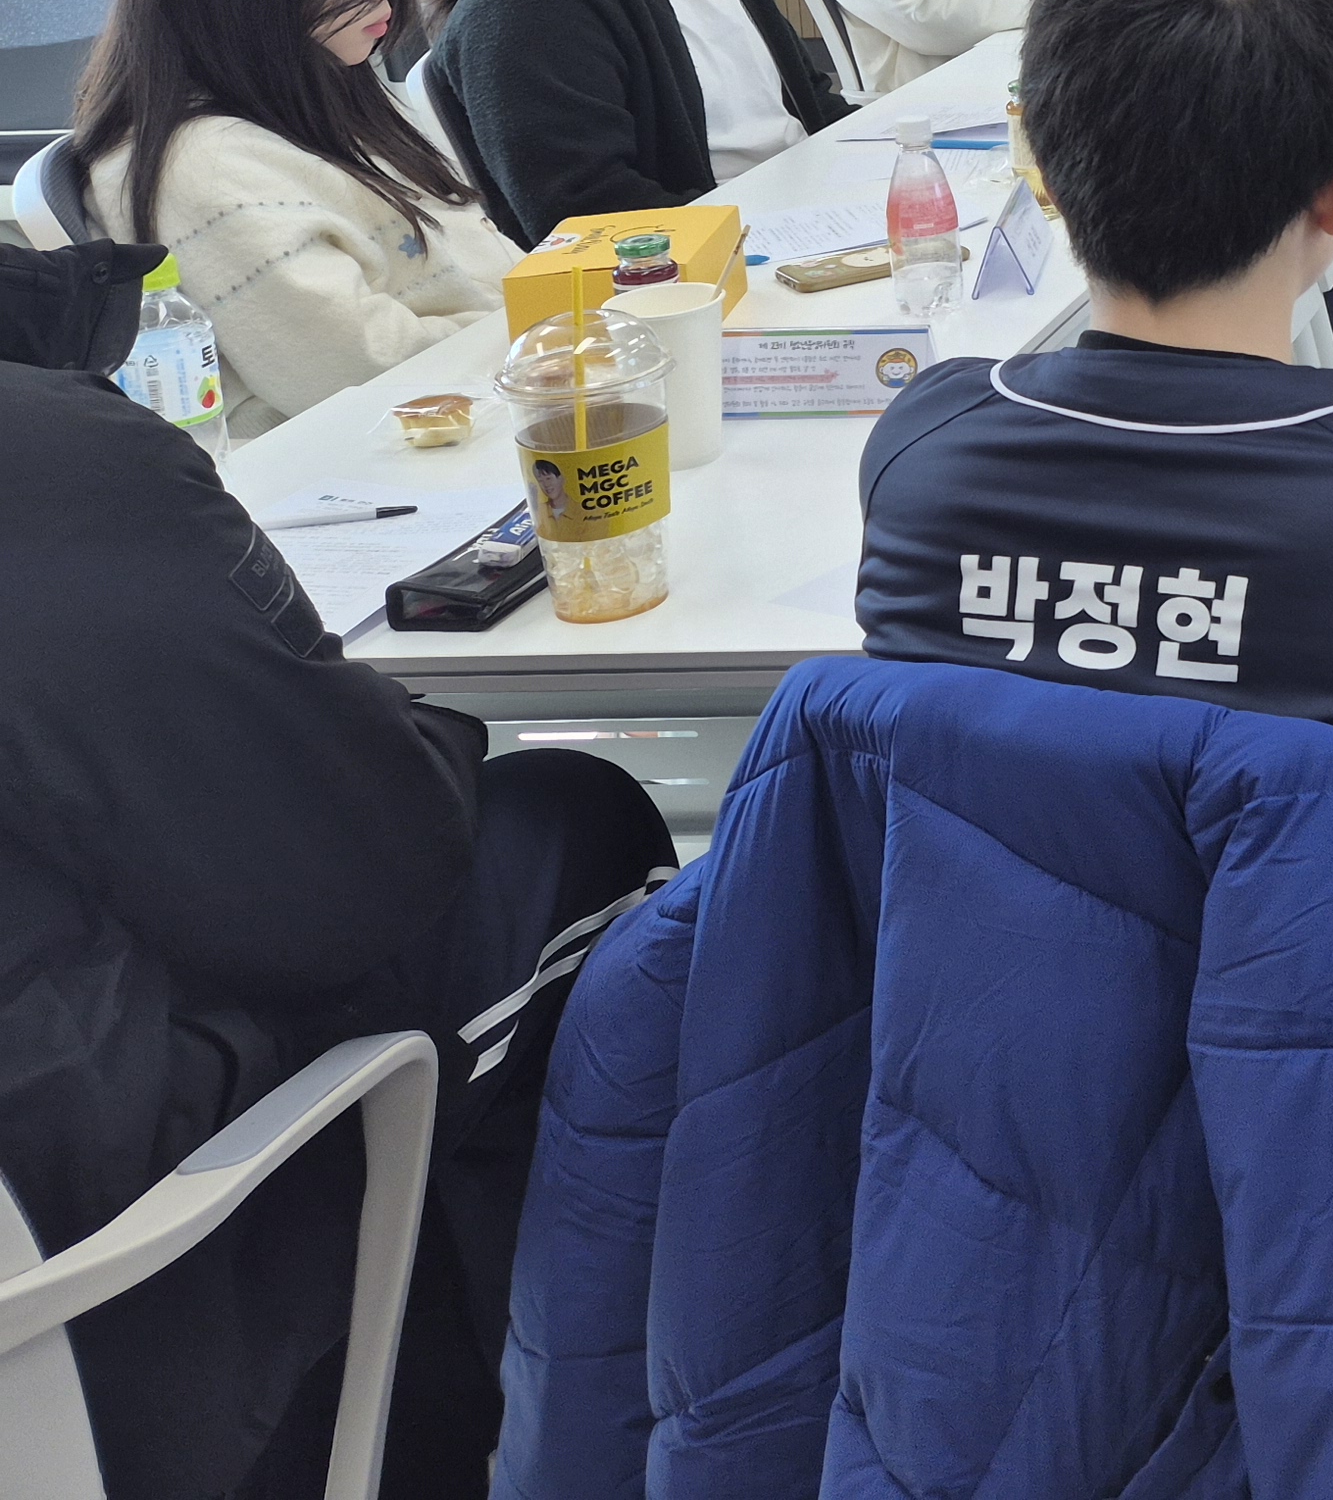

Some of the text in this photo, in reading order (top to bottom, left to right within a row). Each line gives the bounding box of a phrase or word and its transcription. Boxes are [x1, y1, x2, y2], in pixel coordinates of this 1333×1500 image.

[577, 456, 638, 481] MEGA
[578, 475, 629, 496] MGC
[581, 480, 653, 510] COFFEE
[958, 554, 1248, 683] 박정현
